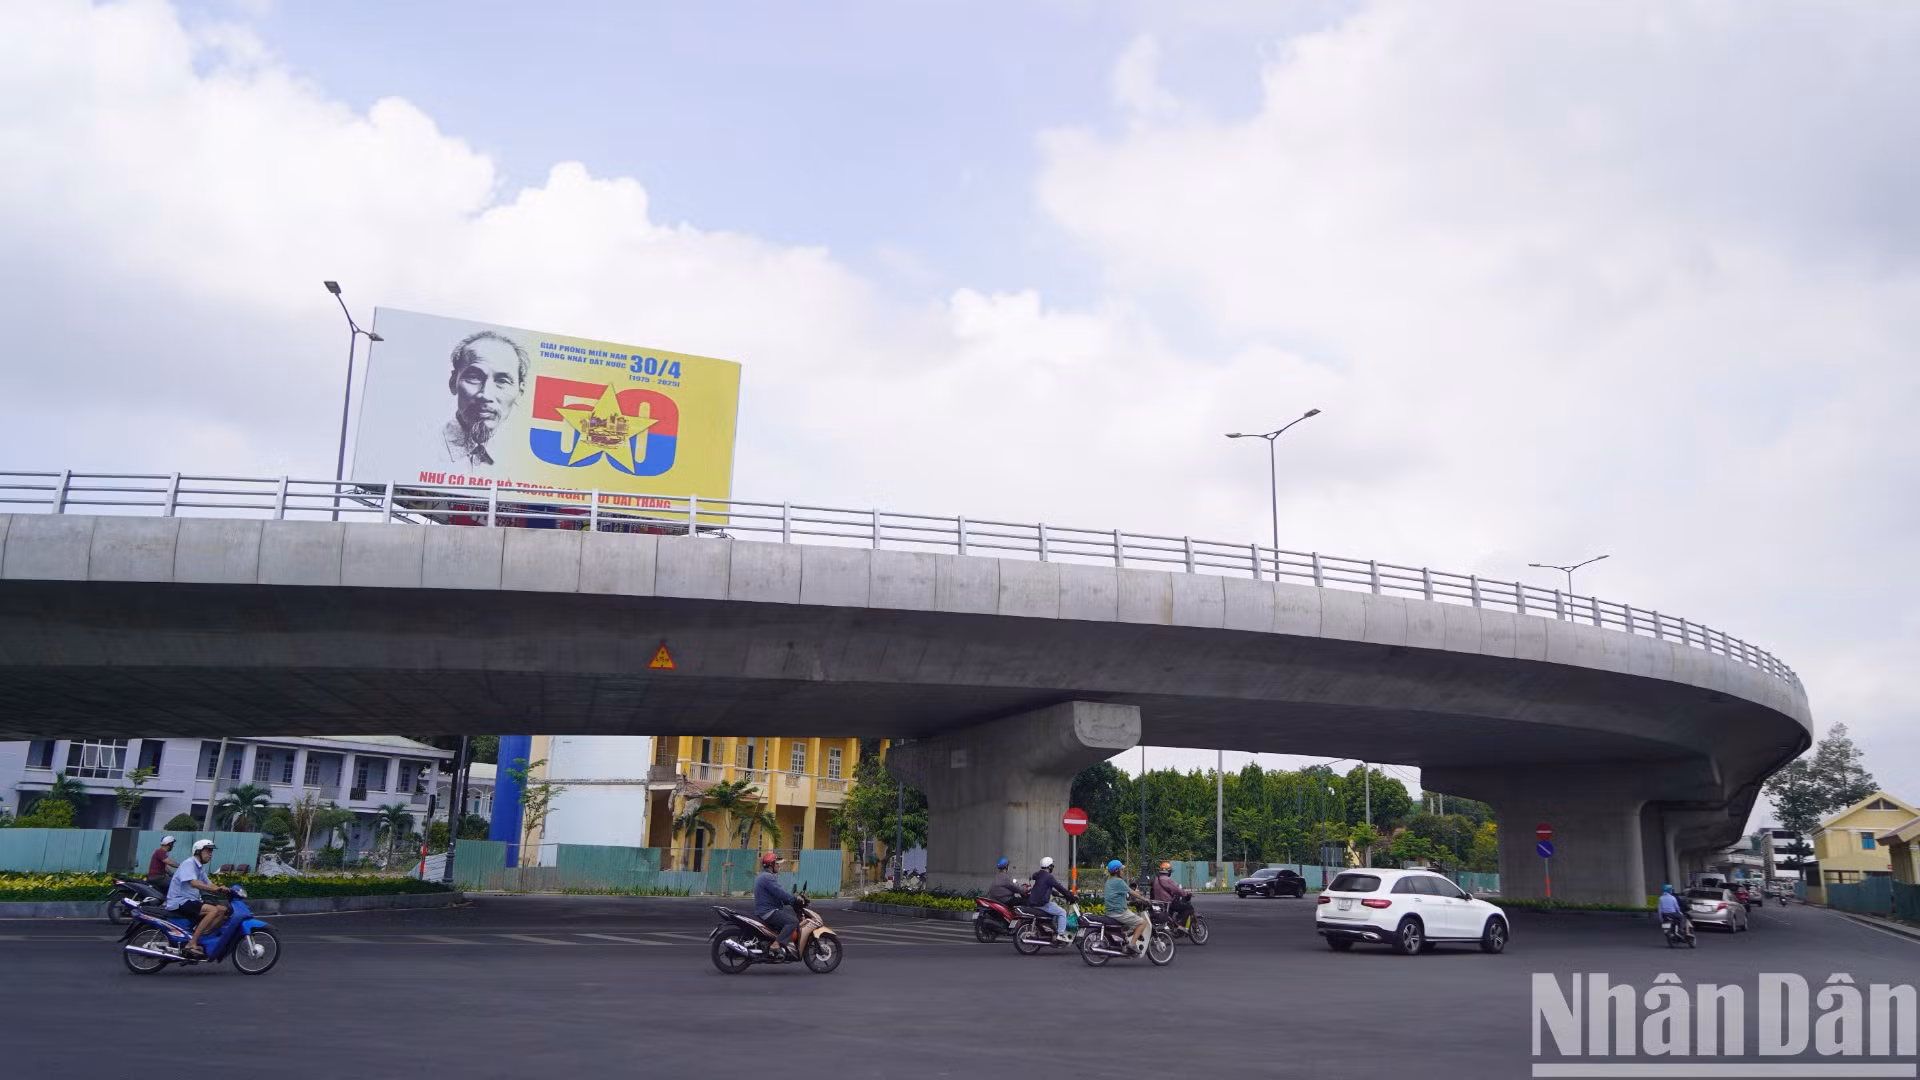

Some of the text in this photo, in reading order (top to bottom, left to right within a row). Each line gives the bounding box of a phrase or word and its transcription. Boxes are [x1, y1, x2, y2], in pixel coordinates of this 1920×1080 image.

[610, 352, 627, 360] NAM
[630, 355, 681, 379] 30/4
[419, 471, 447, 485] NHƯ
